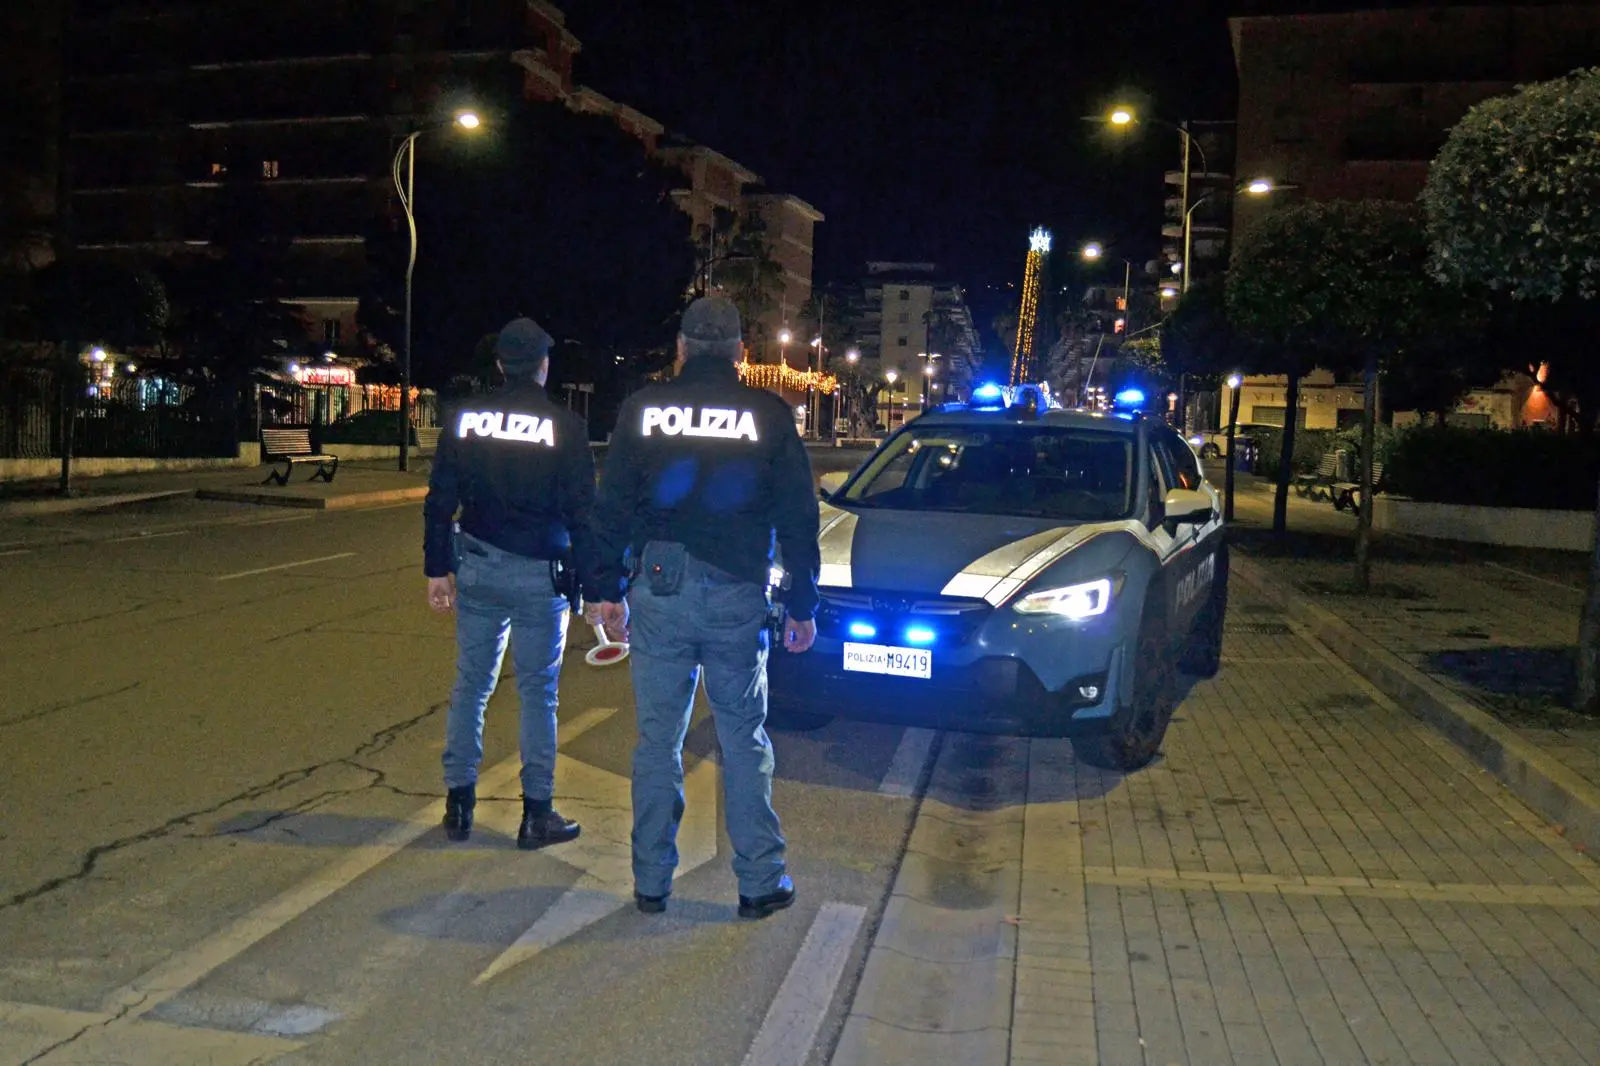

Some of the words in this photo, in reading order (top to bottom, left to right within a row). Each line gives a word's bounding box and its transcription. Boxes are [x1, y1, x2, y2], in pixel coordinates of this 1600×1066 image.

[459, 412, 554, 447] POLIZIA
[642, 407, 759, 441] POLIZIA
[847, 652, 883, 664] POLIZIA
[886, 652, 928, 672] M9419
